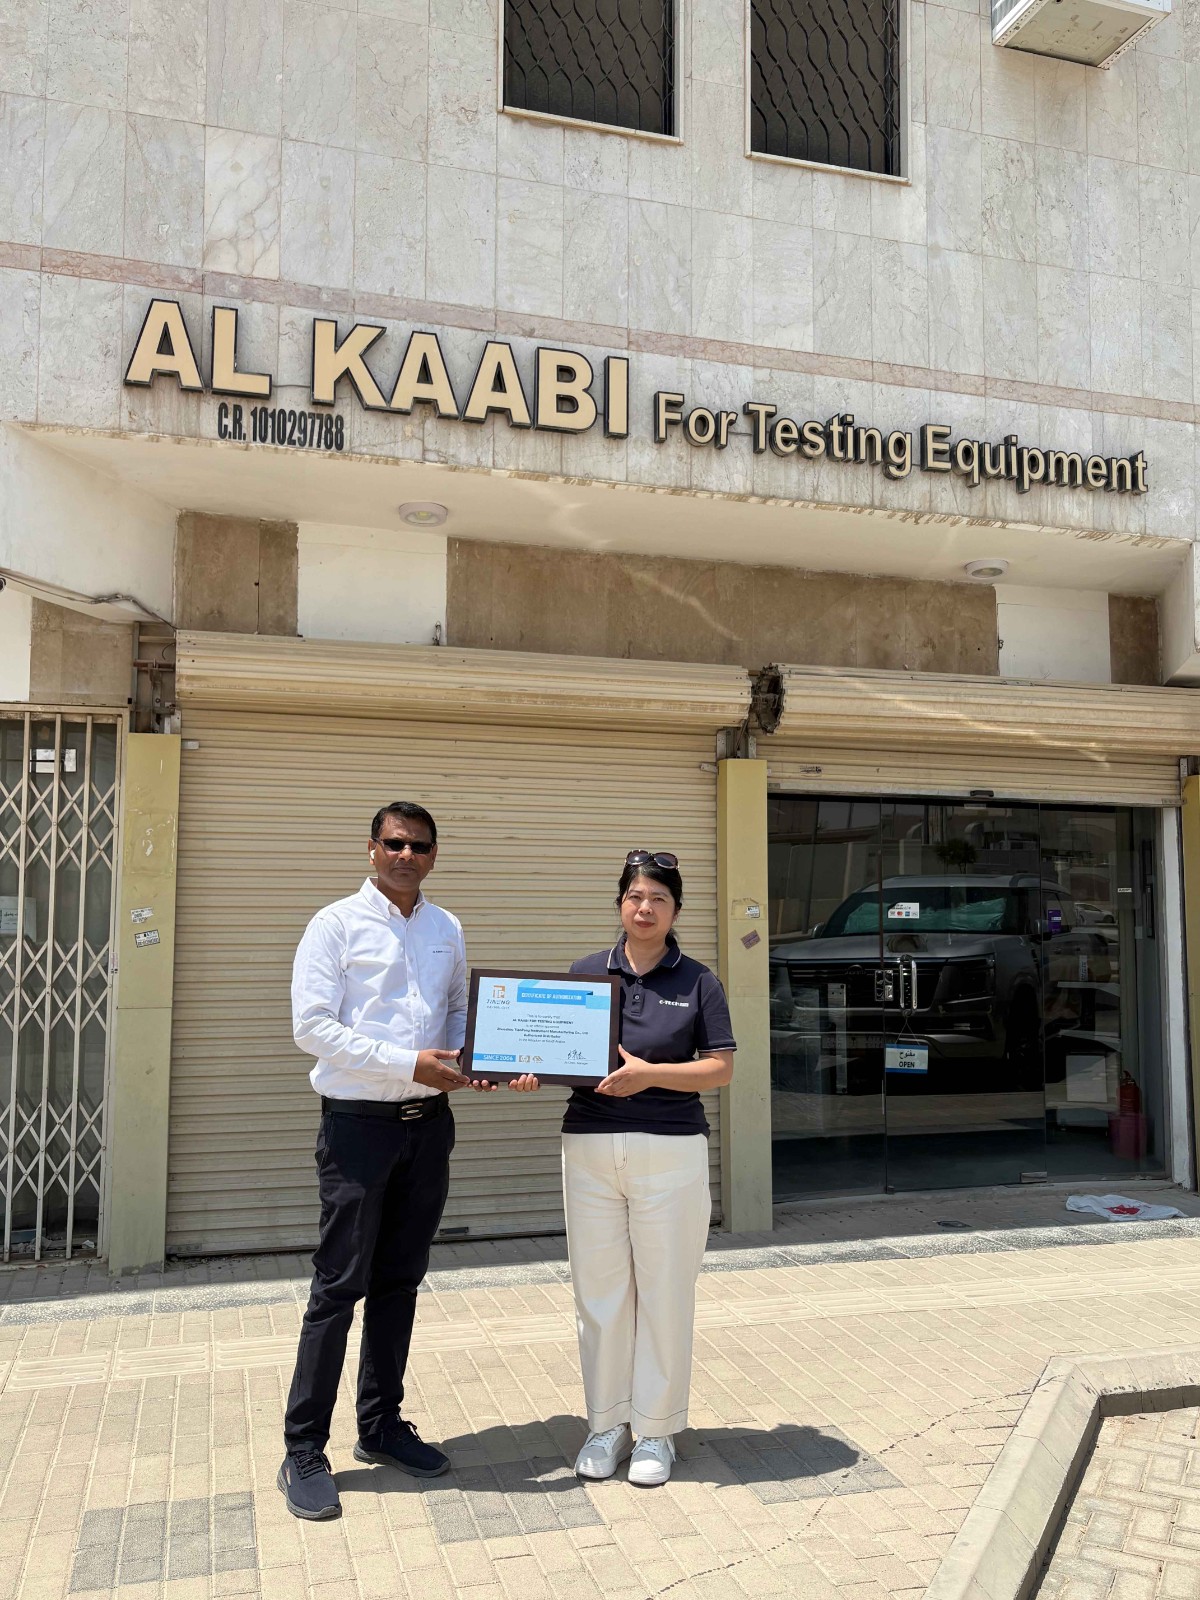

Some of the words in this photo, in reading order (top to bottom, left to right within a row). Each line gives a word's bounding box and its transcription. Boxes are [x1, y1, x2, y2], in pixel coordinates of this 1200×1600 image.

[124, 298, 272, 400] AL
[311, 317, 630, 440] KAABI
[217, 402, 247, 441] C.R.
[250, 406, 344, 451] 1010297788
[654, 391, 737, 450] For
[742, 402, 914, 480] Testing
[919, 423, 1149, 495] Equipment
[899, 1050, 916, 1060] مفتوح
